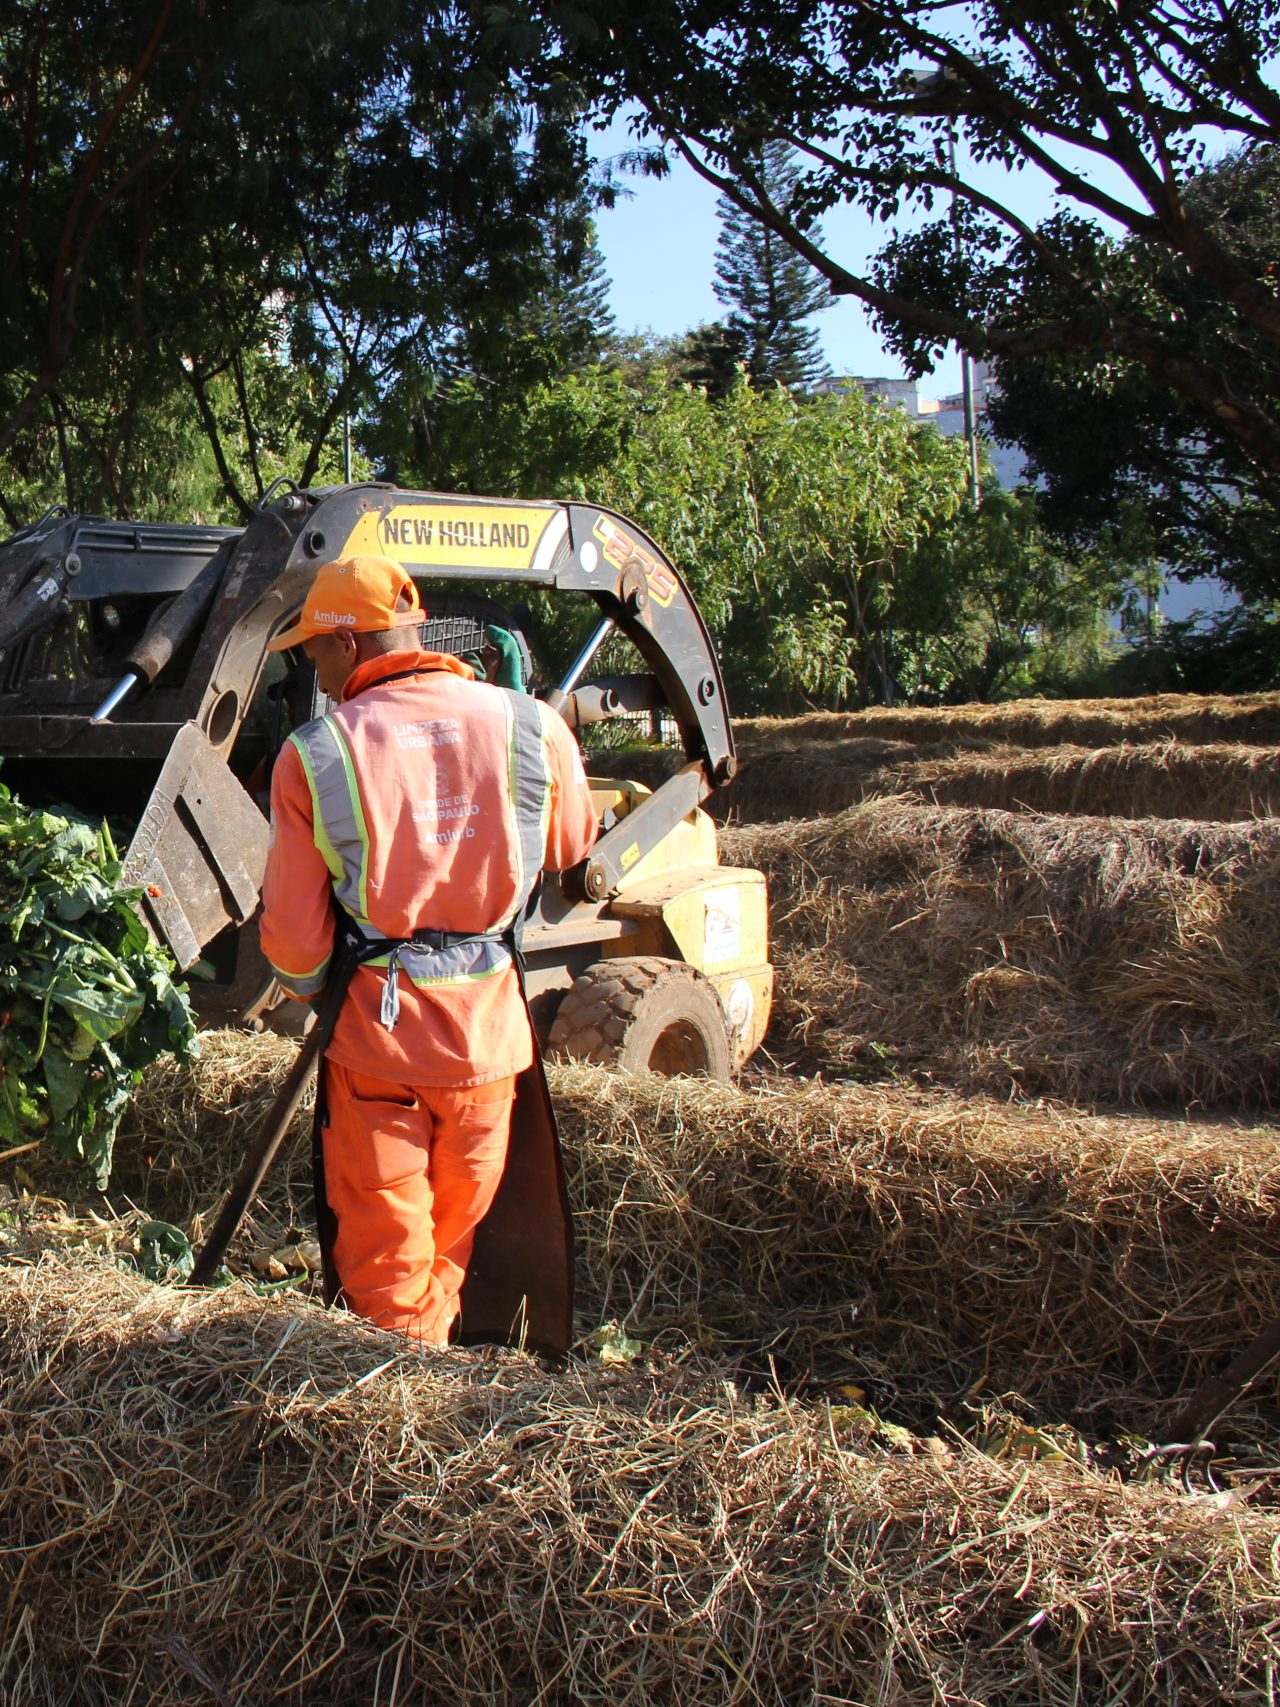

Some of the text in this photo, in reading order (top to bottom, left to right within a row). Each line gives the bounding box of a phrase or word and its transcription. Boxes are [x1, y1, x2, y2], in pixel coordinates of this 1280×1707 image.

[384, 518, 530, 548] NEW HOLLAND
[314, 610, 356, 625] Amlurb
[393, 718, 459, 736] LIMPEZA
[397, 731, 462, 749] URBANA
[453, 794, 469, 805] DE
[438, 805, 480, 821] PAULO
